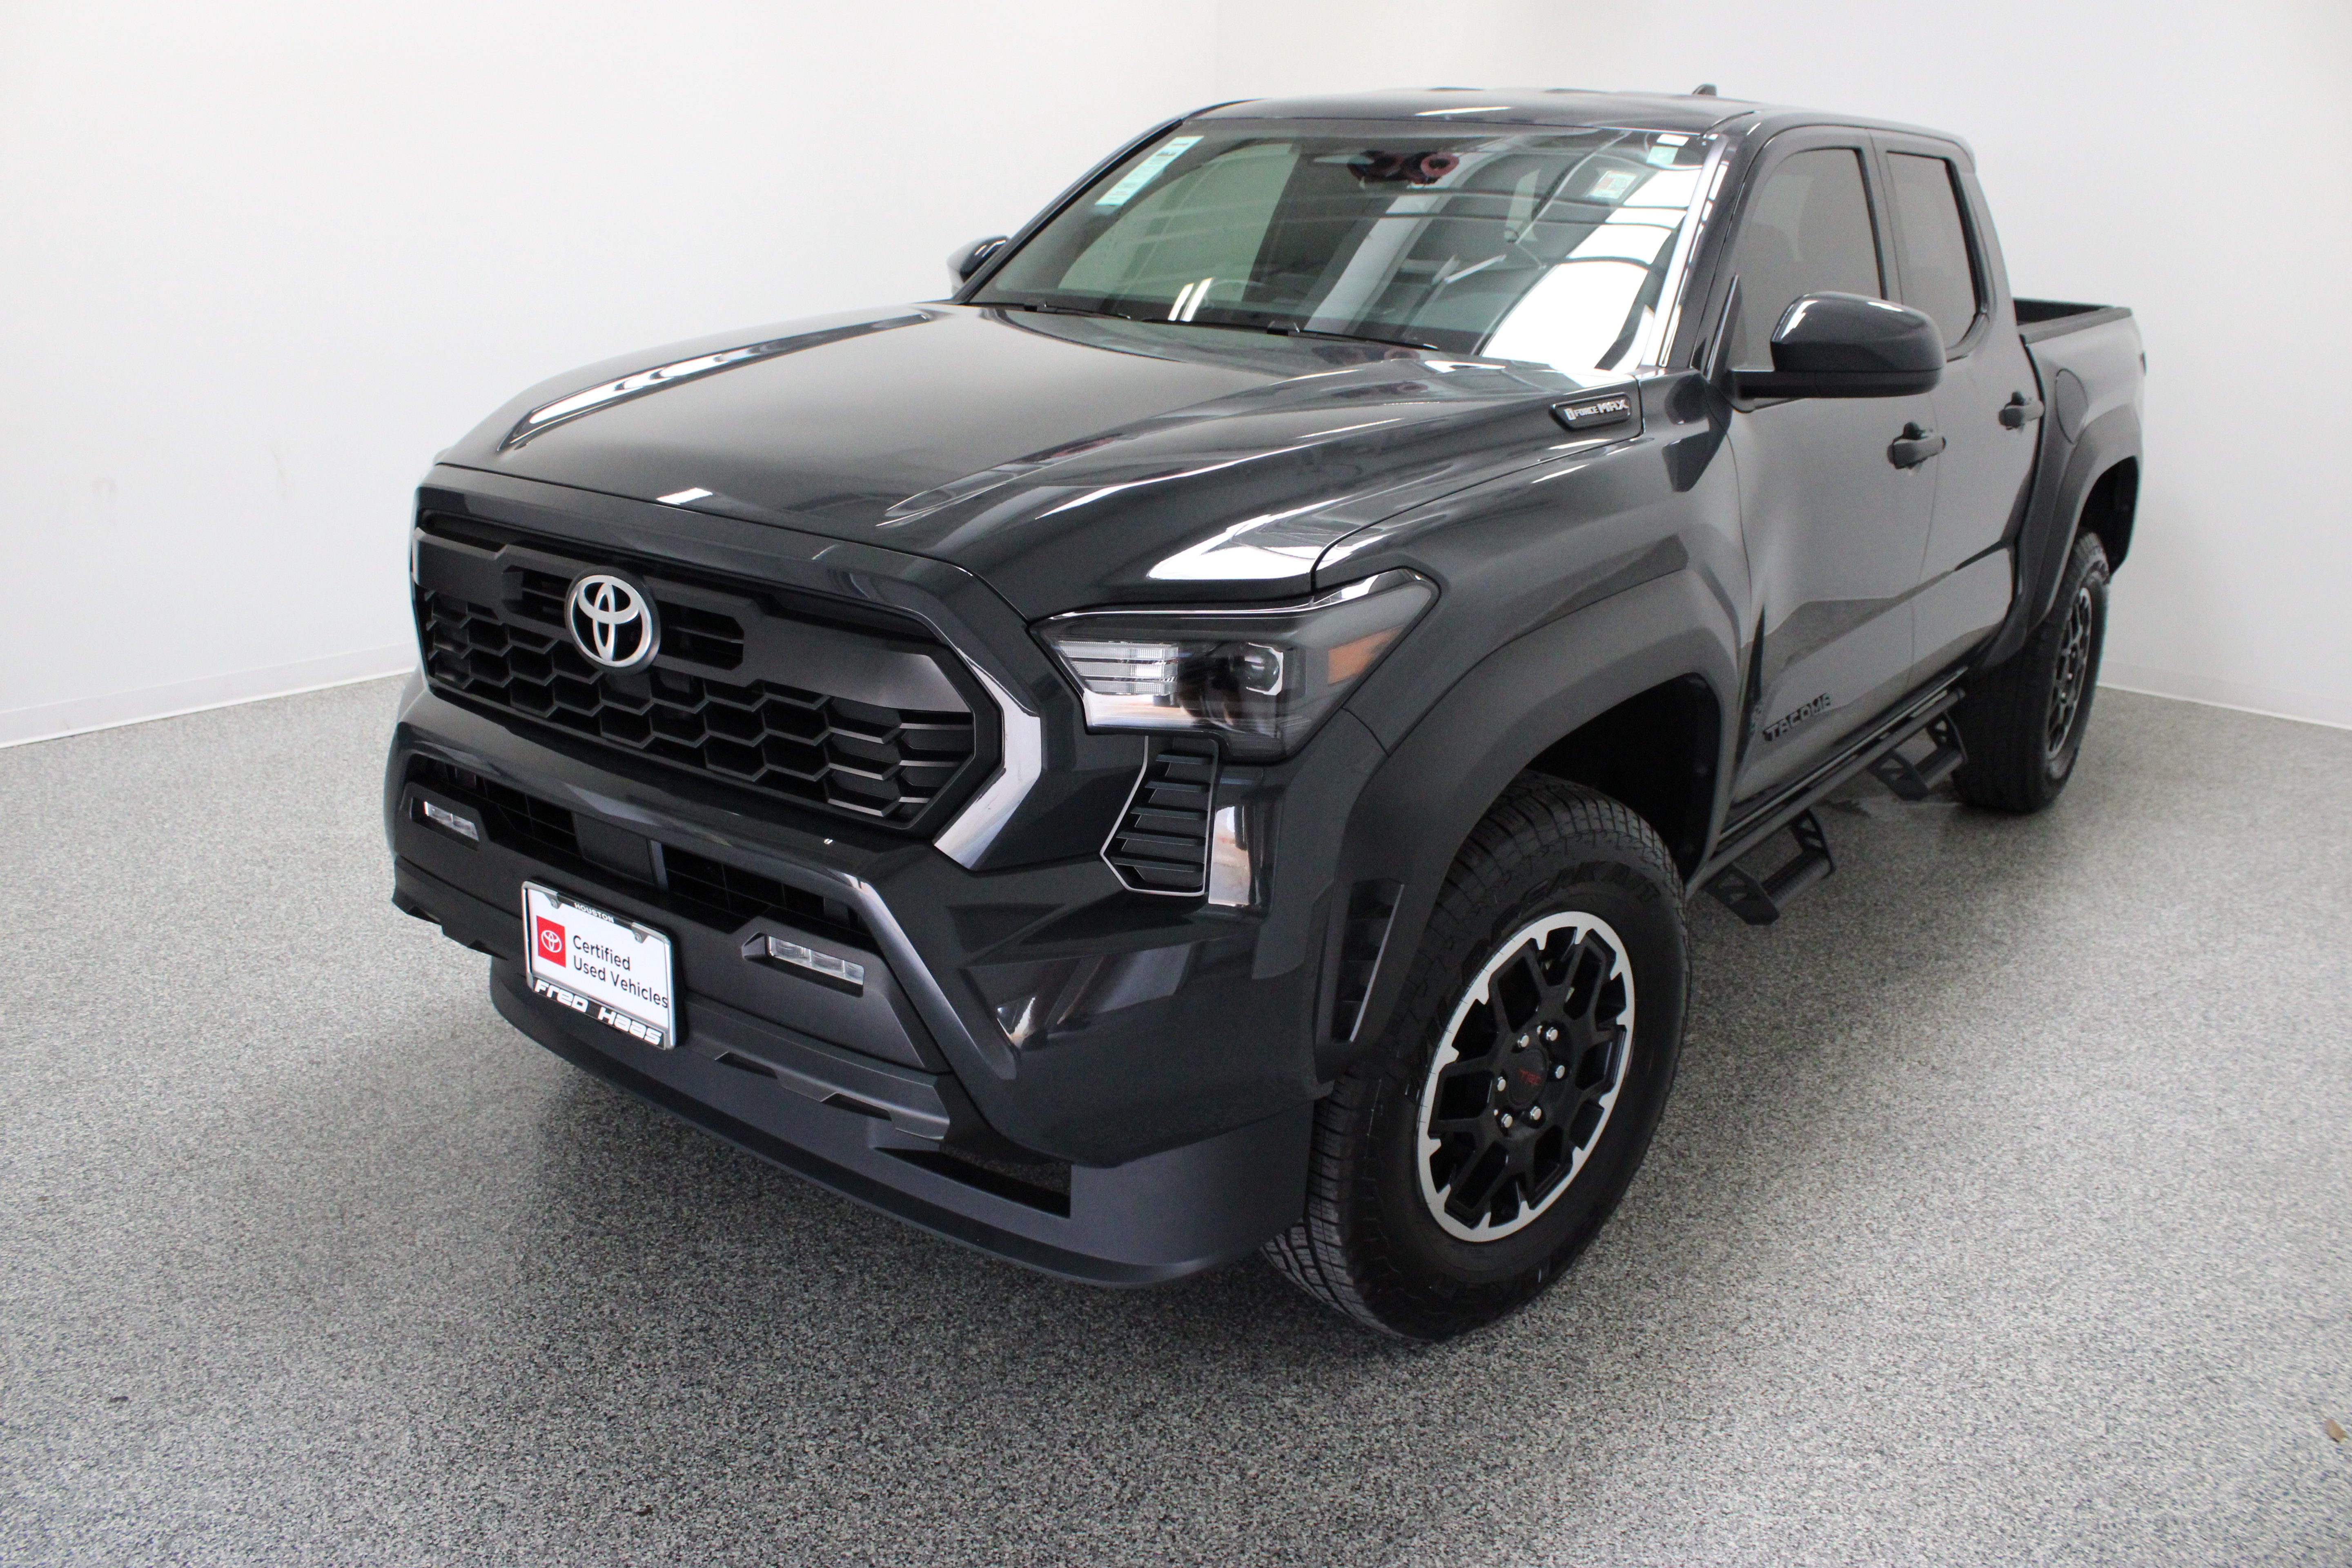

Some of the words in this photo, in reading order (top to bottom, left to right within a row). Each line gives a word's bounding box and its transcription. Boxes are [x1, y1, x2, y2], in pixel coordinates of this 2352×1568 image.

[1763, 693, 1831, 742] TACOMA
[574, 902, 615, 923] HOUSTON
[573, 935, 631, 971] Certified
[574, 955, 606, 981] Used
[610, 971, 668, 1009] Vehicles
